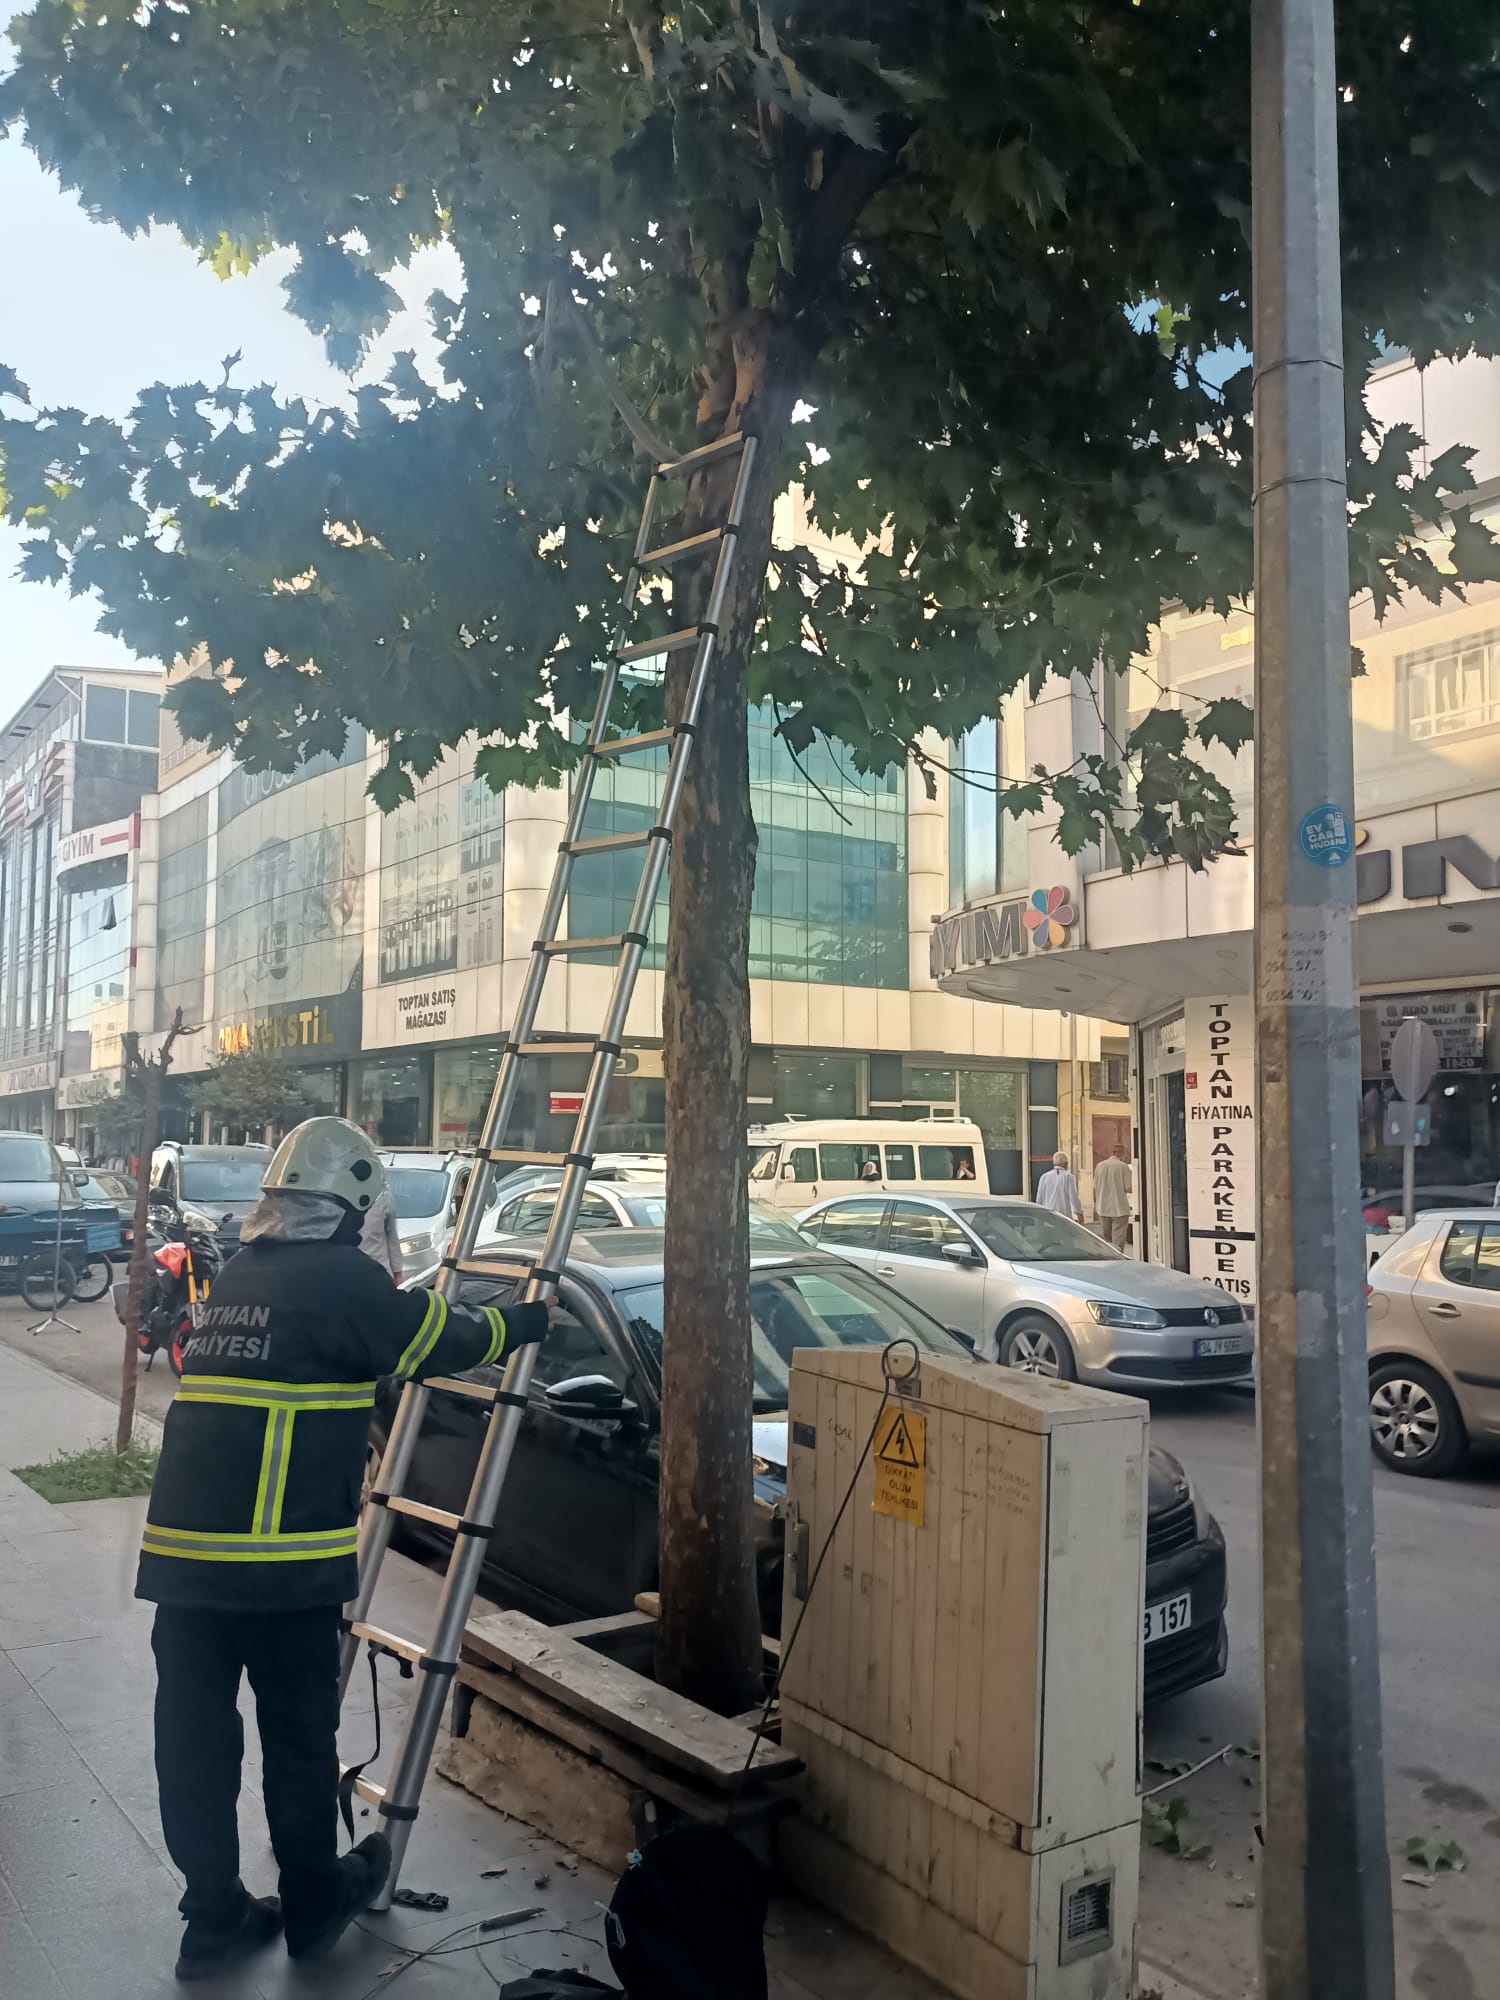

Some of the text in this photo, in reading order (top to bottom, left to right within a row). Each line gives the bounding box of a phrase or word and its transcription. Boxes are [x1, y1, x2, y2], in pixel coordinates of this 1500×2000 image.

[398, 988, 456, 1012] TOPTAN SATIŞ
[405, 1011, 447, 1030] MAĞAZASI
[1209, 1003, 1233, 1098] TOPTAN
[1191, 1102, 1254, 1120] FİYATINA
[180, 1330, 272, 1361] TFAİYESİ
[1159, 1597, 1188, 1634] 157
